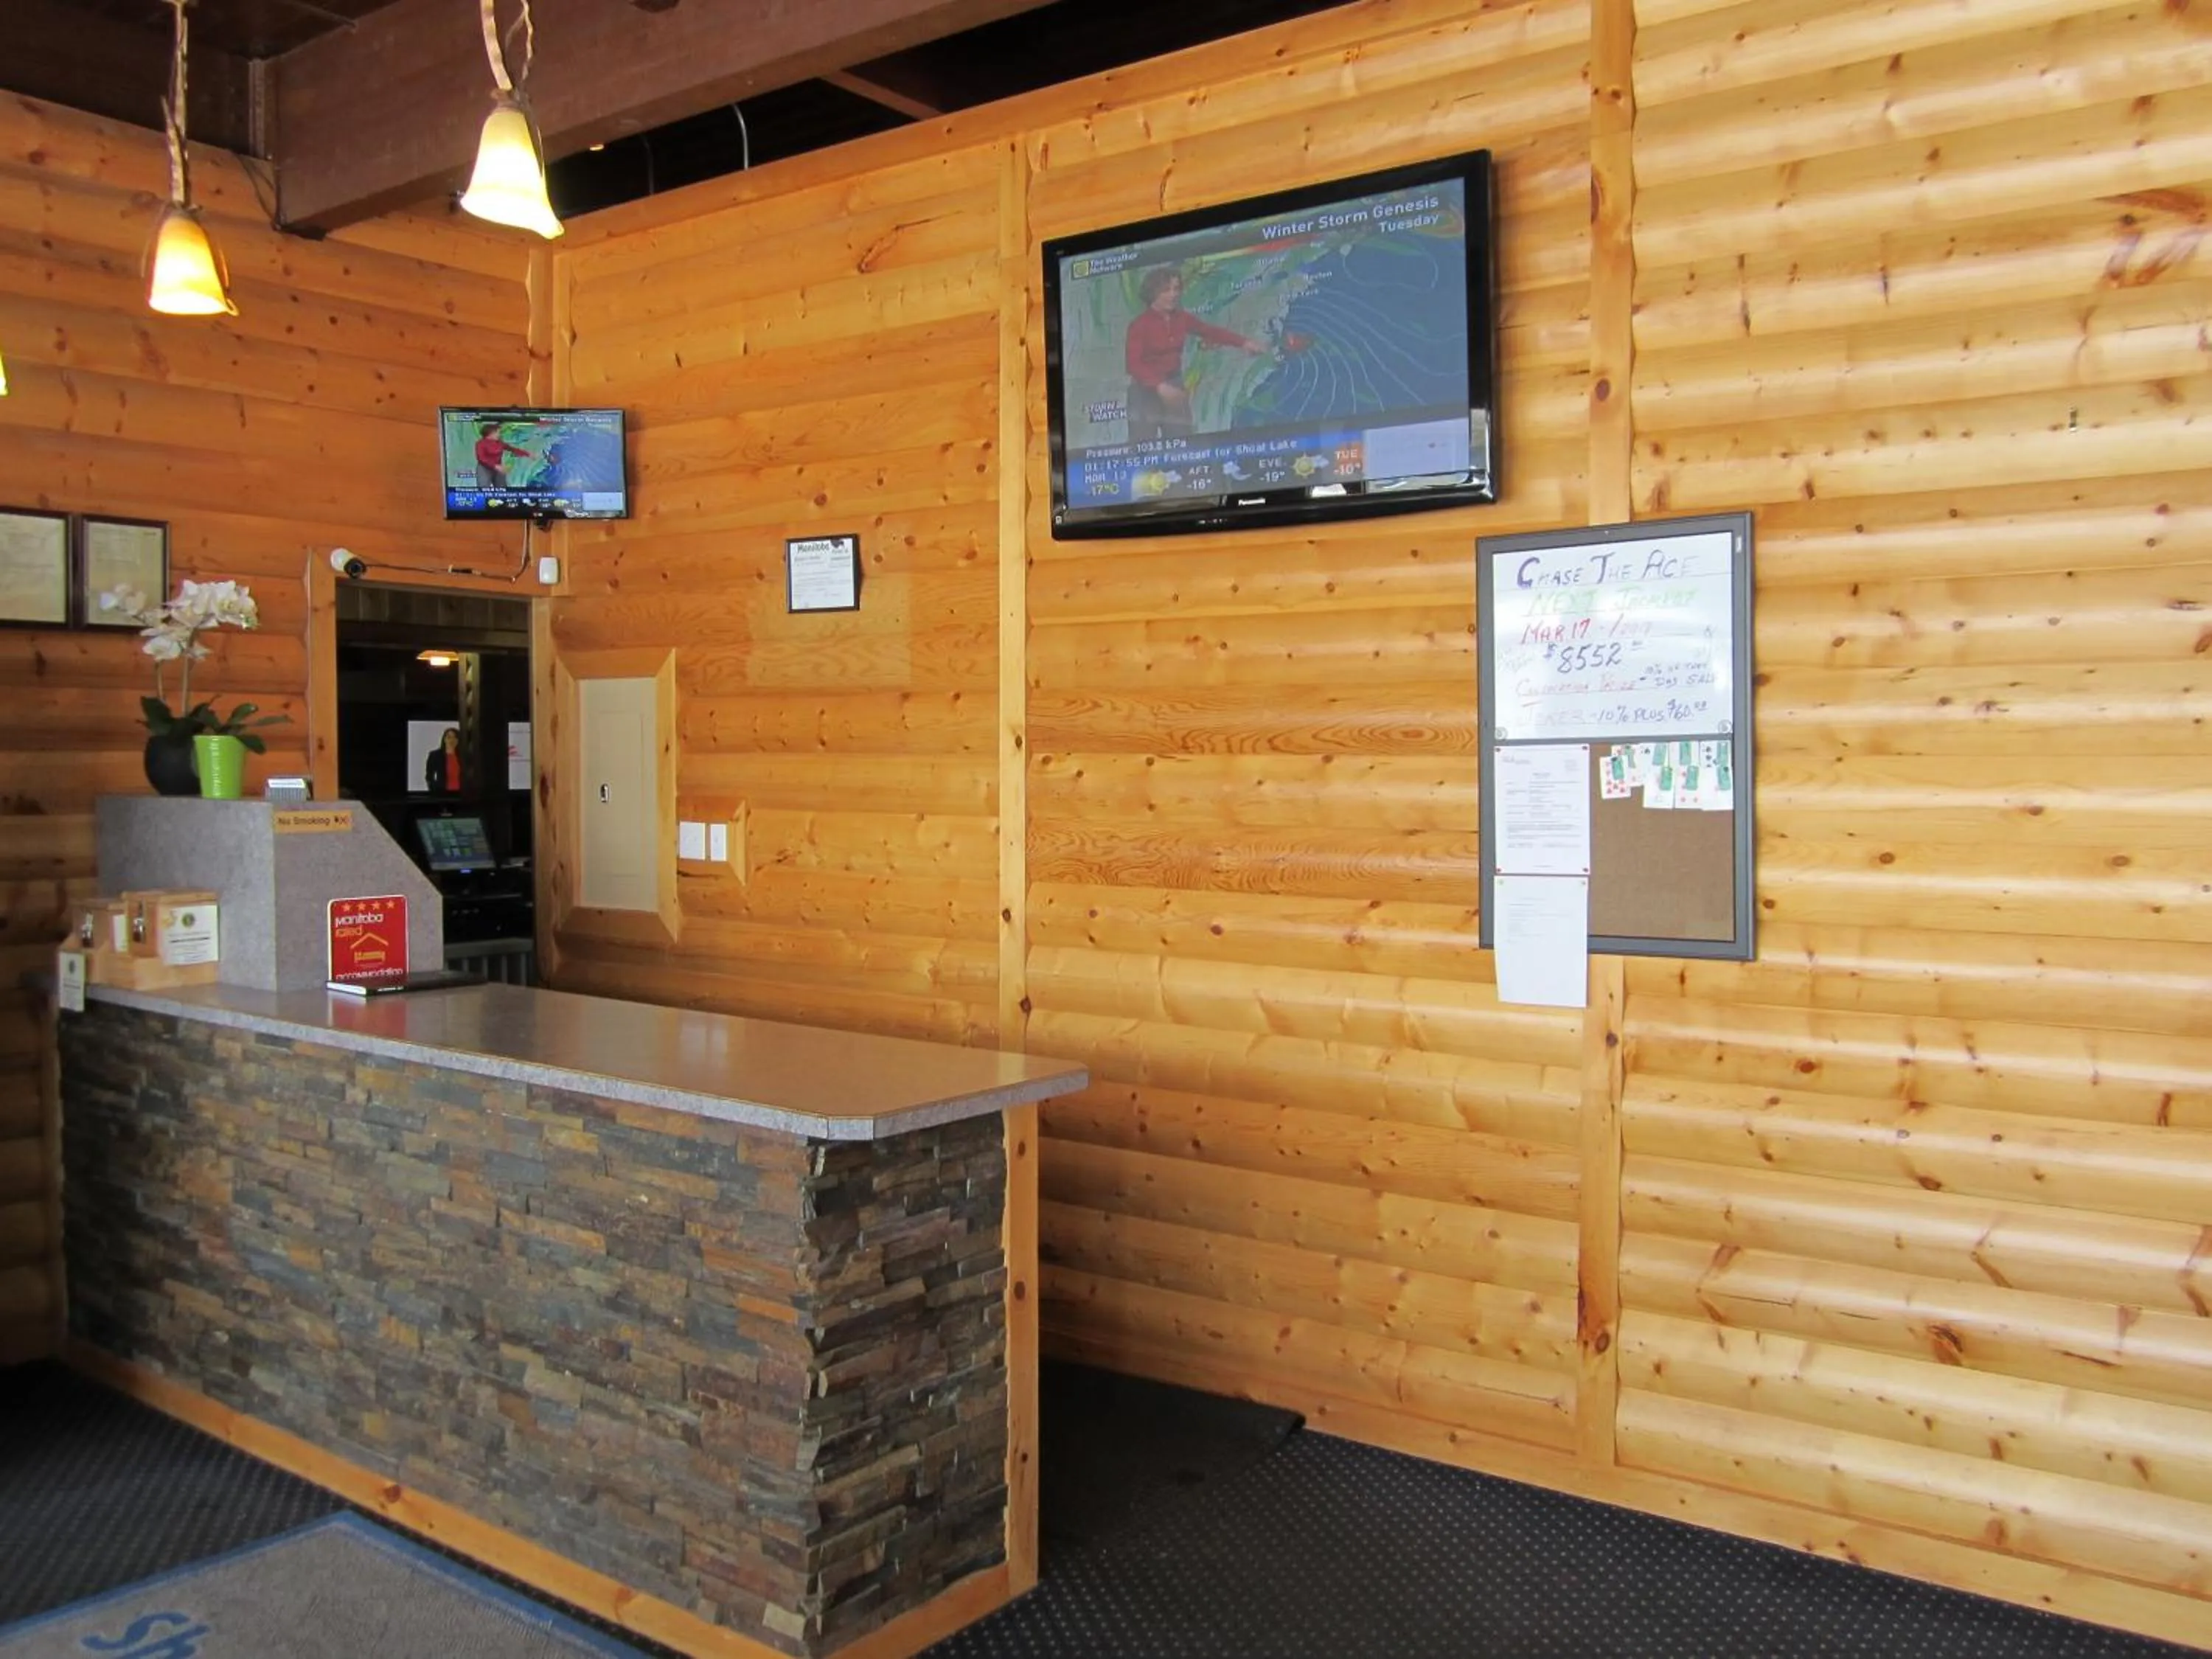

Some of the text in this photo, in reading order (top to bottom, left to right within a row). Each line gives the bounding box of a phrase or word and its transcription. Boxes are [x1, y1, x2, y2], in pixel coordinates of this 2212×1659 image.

[1262, 195, 1439, 240] Winter Storm Genesis
[1380, 214, 1439, 233] Tuesday
[1164, 448, 1211, 463] Forecast
[1216, 447, 1231, 458] for
[1236, 443, 1267, 456] Shoal
[1270, 440, 1298, 451] Lake
[1165, 439, 1187, 450] kPa
[1335, 449, 1358, 460] TUE
[1517, 549, 1699, 588] CHASE THE ACE
[1633, 707, 1665, 723] PLUS
[293, 816, 331, 827] Smoking
[335, 911, 384, 928] Manitoba
